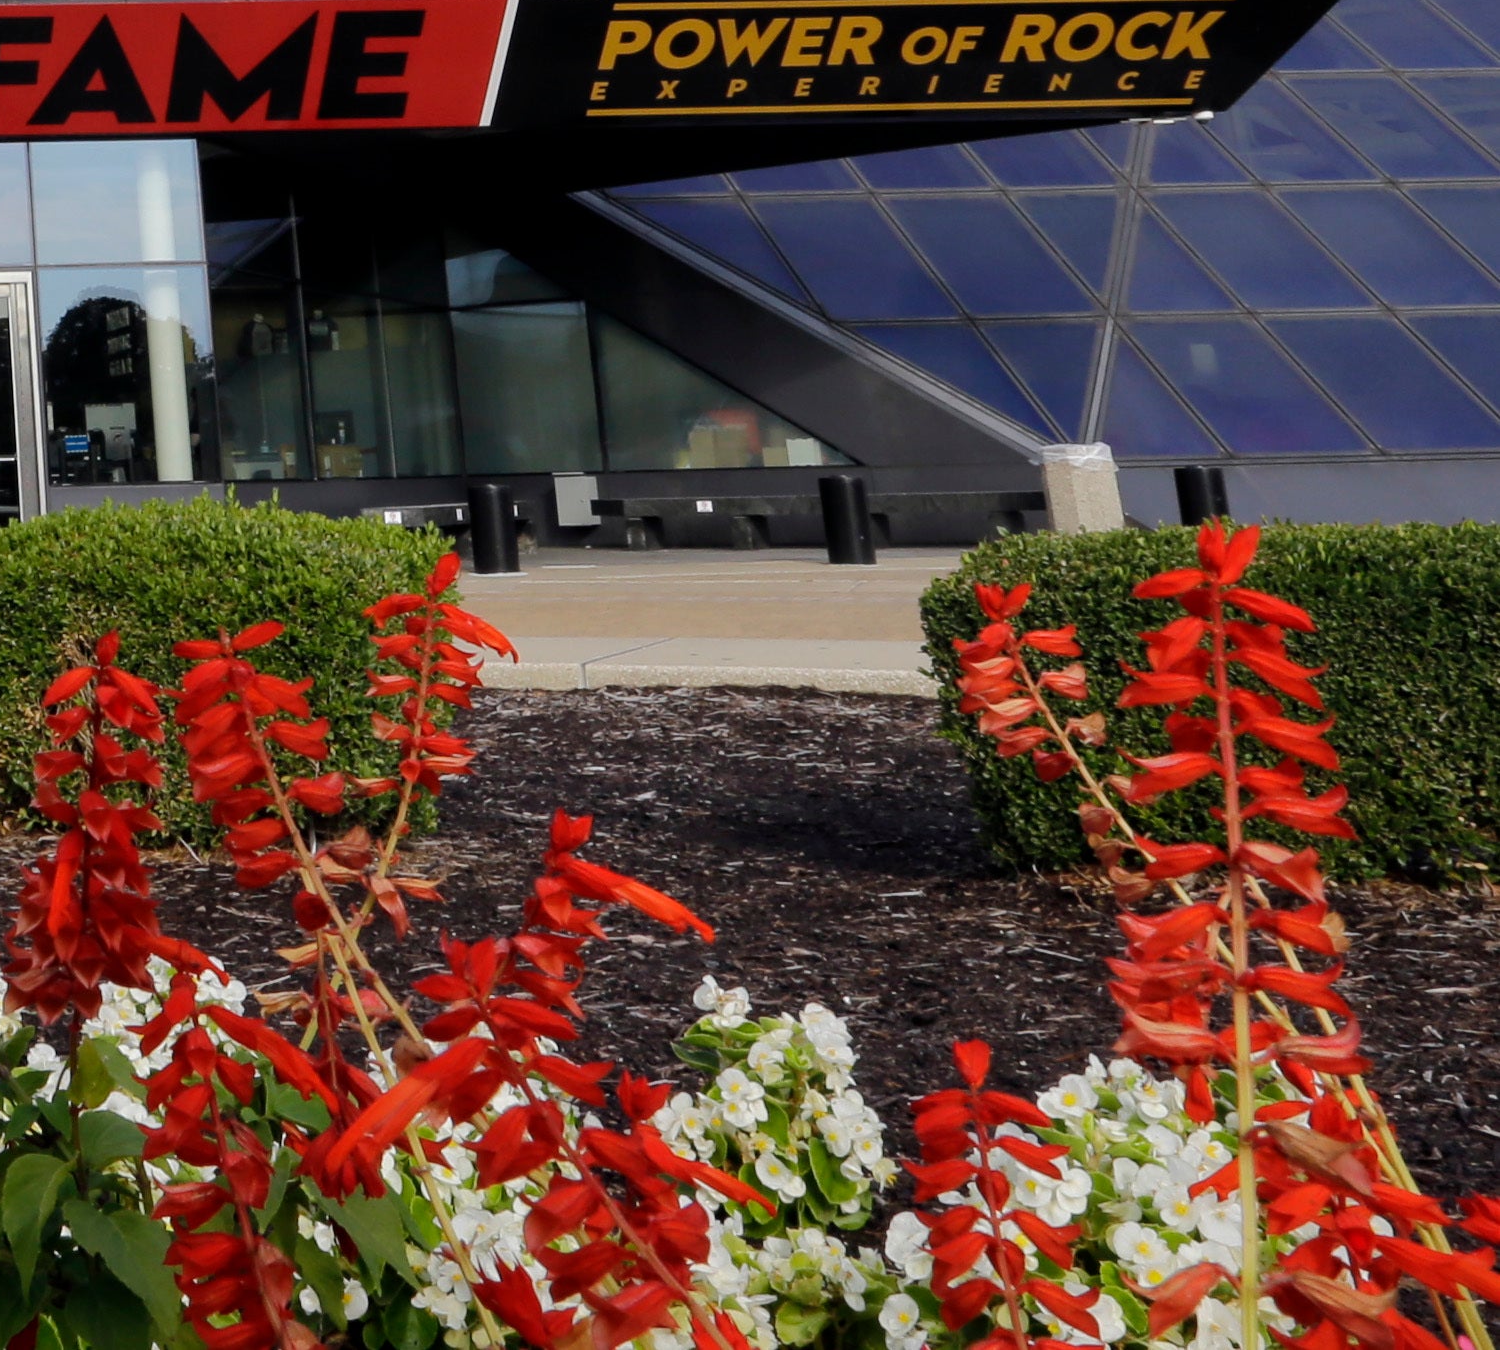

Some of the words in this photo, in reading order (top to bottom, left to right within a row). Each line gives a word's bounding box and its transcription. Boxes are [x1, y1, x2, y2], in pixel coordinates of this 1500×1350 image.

[598, 16, 884, 70] POWER
[901, 26, 985, 65] OF
[1000, 10, 1226, 65] ROCK
[589, 70, 1206, 102] EXPERIENCE
